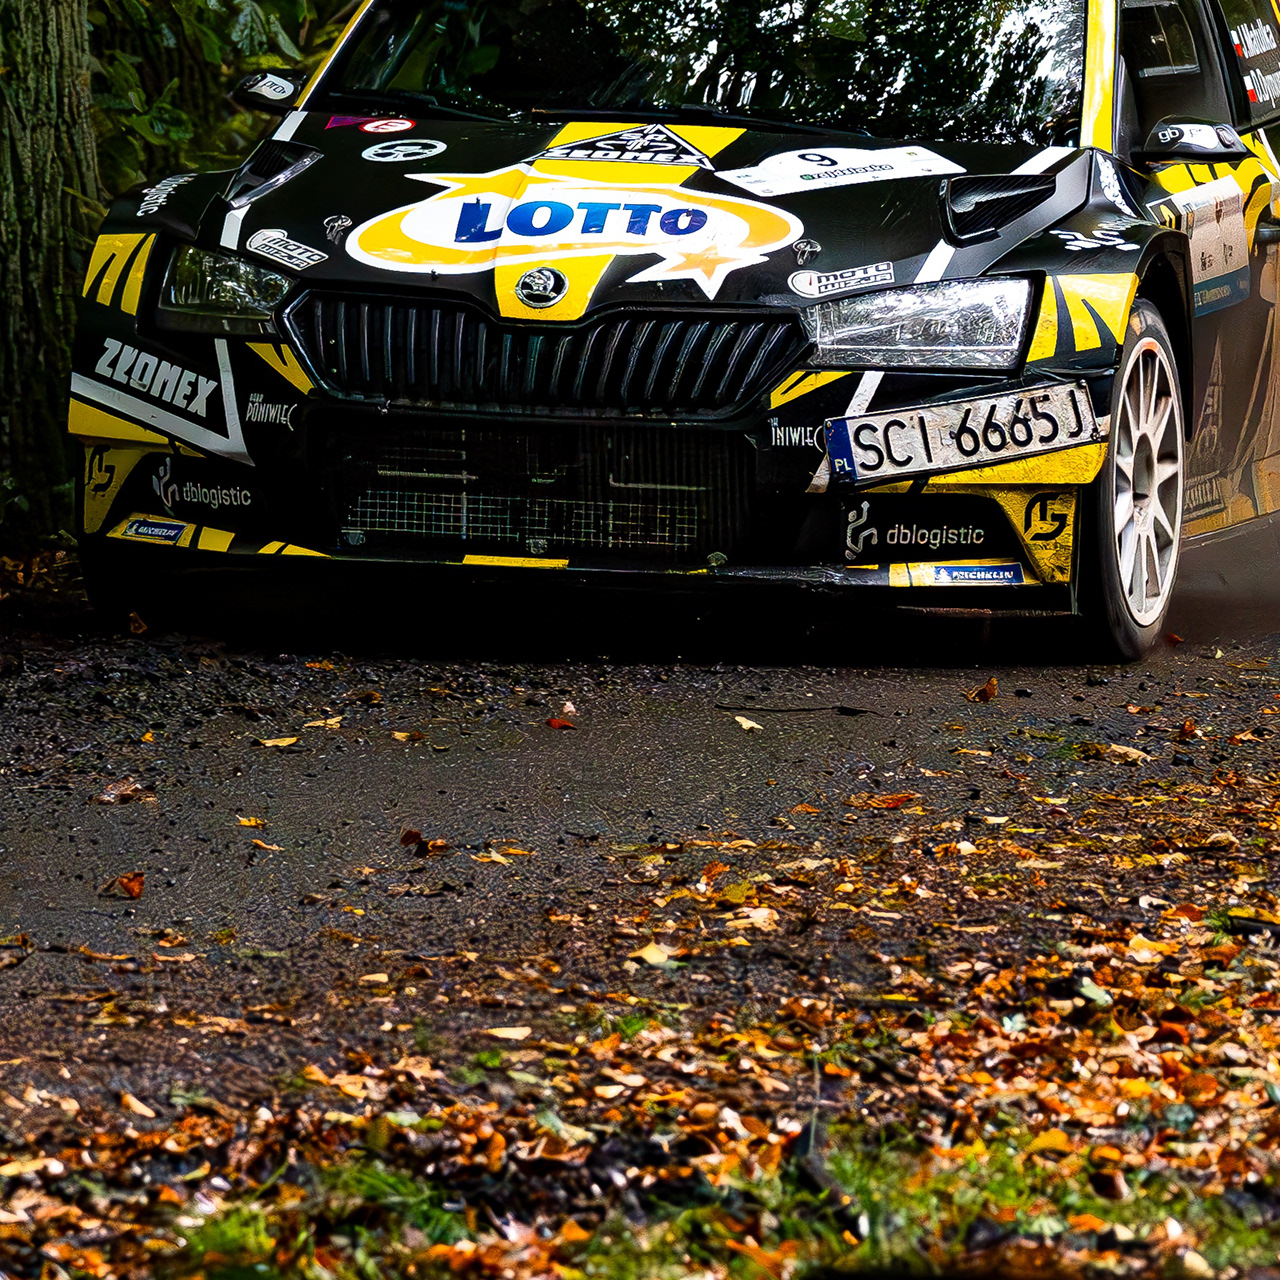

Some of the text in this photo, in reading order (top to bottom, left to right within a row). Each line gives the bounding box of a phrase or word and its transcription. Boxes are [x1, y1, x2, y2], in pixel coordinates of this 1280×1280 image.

[797, 152, 839, 167] 9
[454, 200, 708, 243] LOTTO
[817, 261, 892, 284] MOTO
[853, 388, 1081, 472] SCI 6665J
[834, 458, 852, 472] PL
[183, 481, 252, 510] dblogistic
[886, 523, 985, 550] dblogistic
